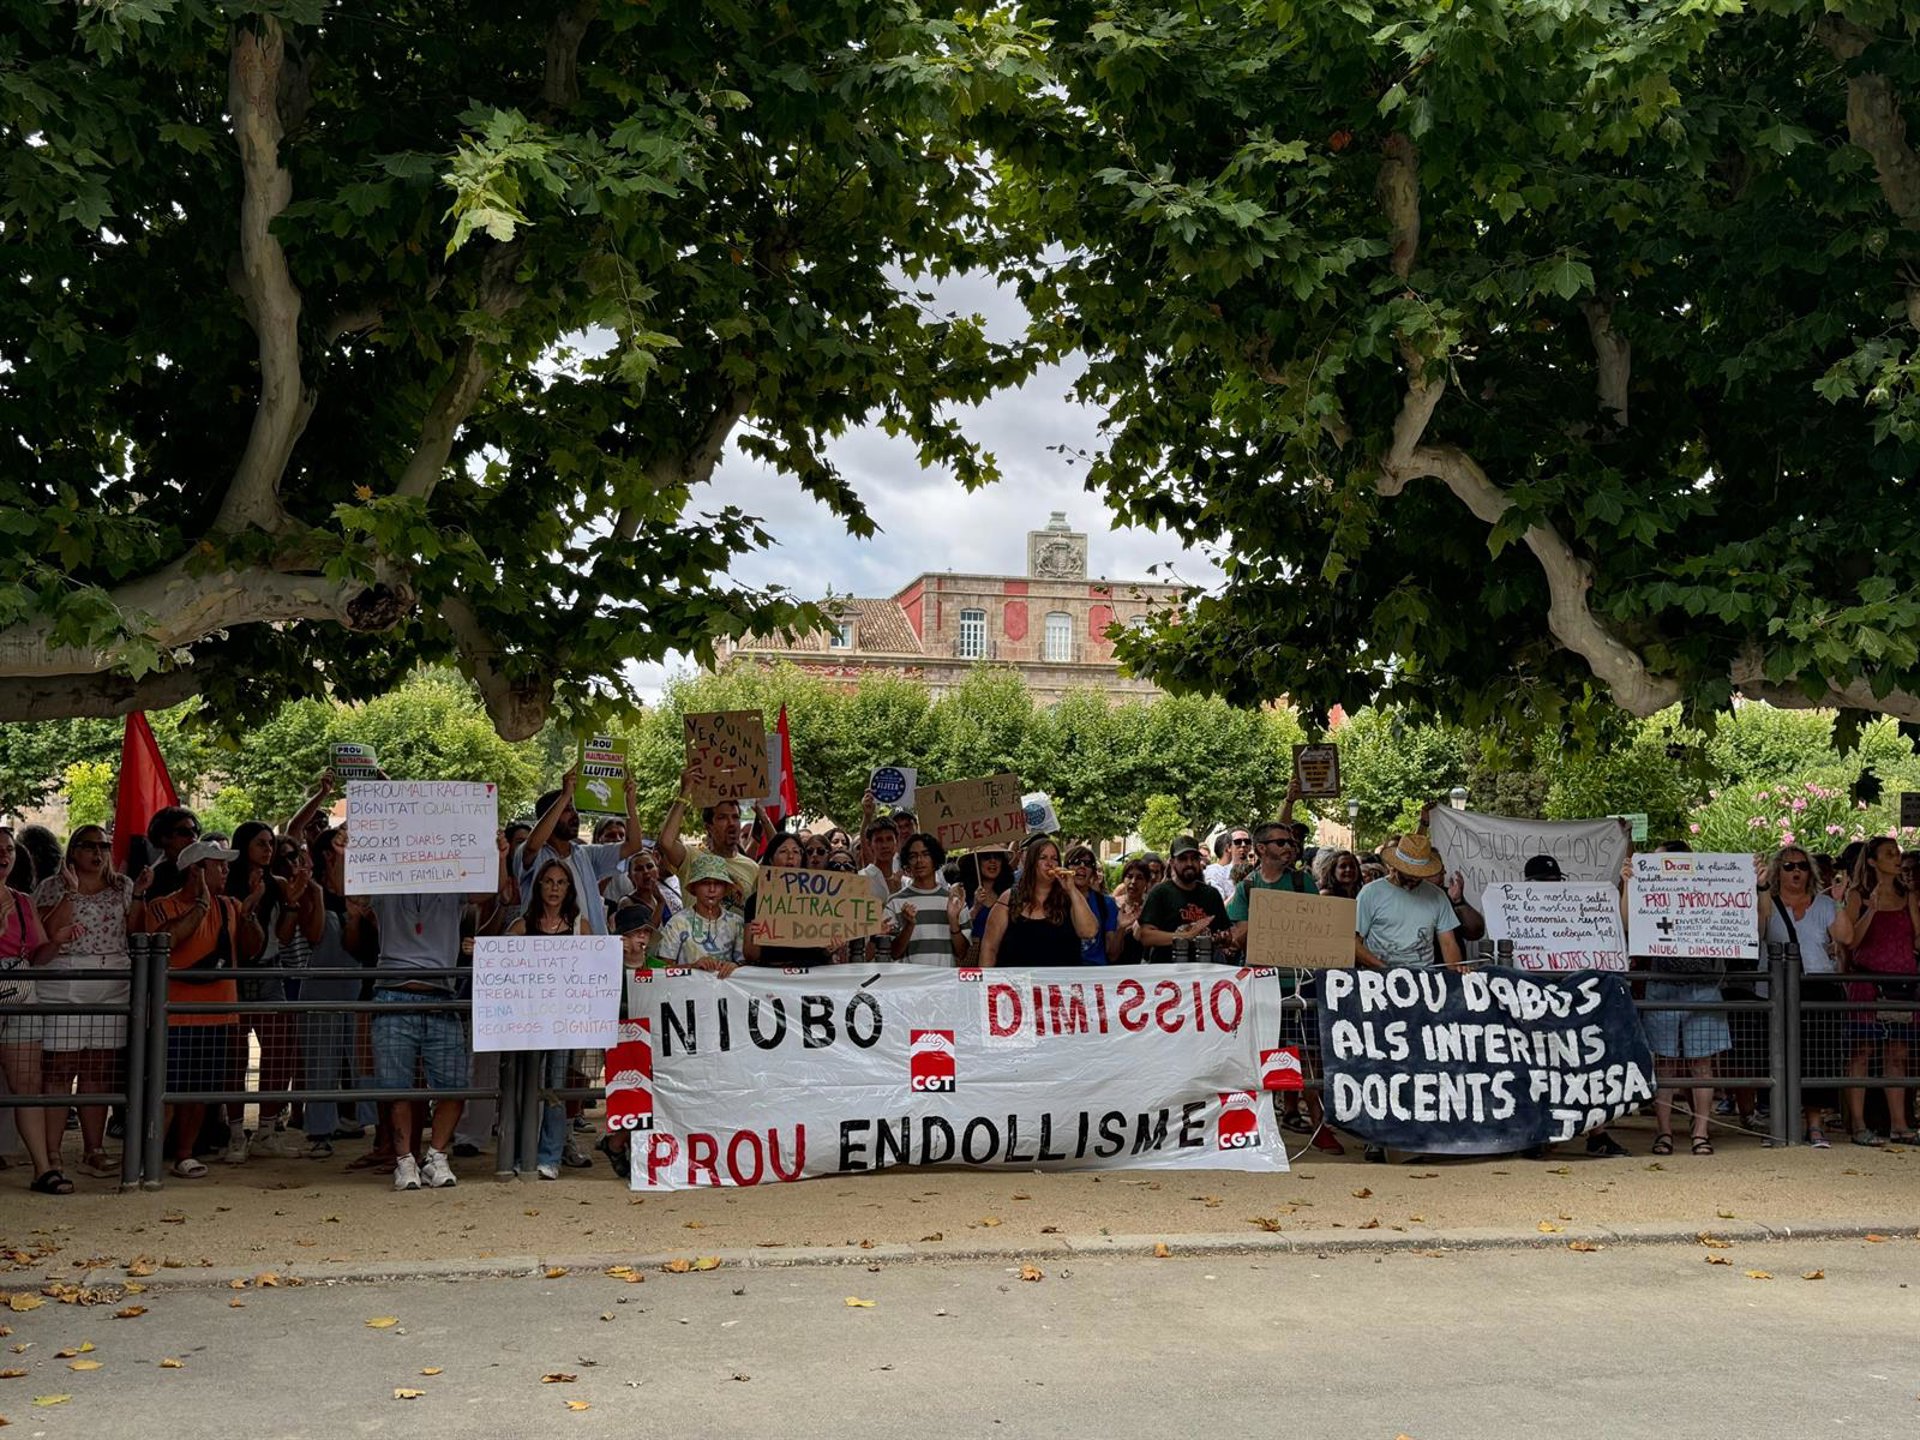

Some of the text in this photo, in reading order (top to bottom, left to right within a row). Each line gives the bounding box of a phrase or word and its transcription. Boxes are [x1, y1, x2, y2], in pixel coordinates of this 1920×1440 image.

[338, 768, 377, 777] LLUITEM
[583, 765, 625, 778] LLUITEM
[350, 819, 398, 831] DRETS
[450, 834, 477, 848] PER
[356, 870, 403, 883] TENIM
[780, 871, 845, 896] PROU
[1501, 883, 1523, 901] Per
[1526, 887, 1540, 901] la
[1543, 888, 1583, 902] nostra
[1643, 888, 1753, 909] PROU IMPROVISACIÓ
[757, 895, 879, 922] MALTRACTE
[1502, 903, 1519, 916] per
[1523, 901, 1536, 913] les
[1540, 902, 1578, 914] nostres
[759, 918, 785, 940] AL
[477, 939, 526, 953] VOLEU
[1648, 943, 1679, 955] NIUBÓ
[1518, 950, 1626, 971] PELS NOSTRES DRETS
[634, 975, 653, 983] CGT
[666, 967, 691, 976] CGT
[959, 971, 983, 981] CGT
[1254, 968, 1276, 978] CGT
[475, 973, 609, 986] NOSALTRES VOLEM
[475, 988, 534, 1000] TREBALL
[541, 988, 557, 999] DE
[1325, 968, 1447, 1013] PROU
[660, 972, 883, 1057] NIUBÓ
[1331, 1019, 1606, 1070] ALS INTERINS
[911, 1075, 955, 1091] CGT
[1333, 1061, 1652, 1124] DOCENTS FIXESA
[607, 1113, 653, 1130] CGT
[647, 1101, 1207, 1187] PROU ENDOLLISME
[1219, 1132, 1260, 1148] CGT
